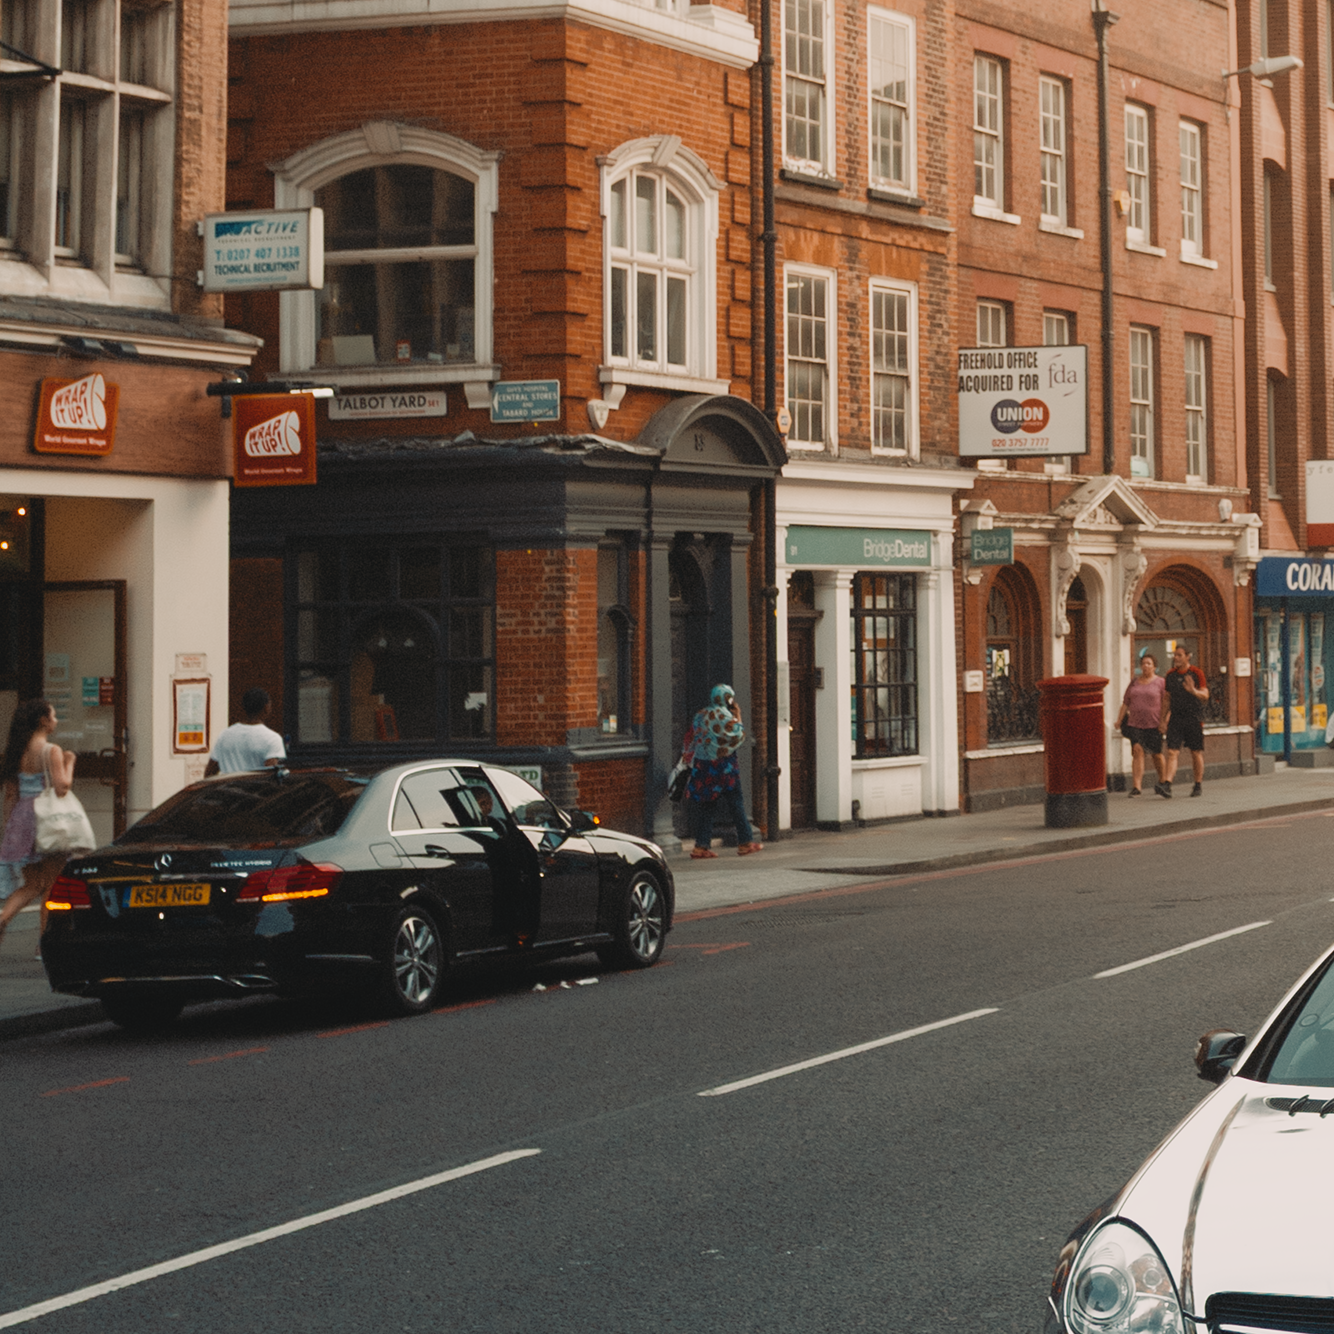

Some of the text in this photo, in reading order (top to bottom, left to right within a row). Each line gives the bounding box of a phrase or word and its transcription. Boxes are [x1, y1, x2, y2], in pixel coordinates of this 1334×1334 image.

[255, 248, 273, 260] 407
[214, 261, 300, 276] TECHNICAL RECRUITMENT
[958, 352, 1039, 371] FREEHOLD OFFICE
[1047, 363, 1078, 388] fda
[958, 374, 1040, 394] ACQUIRED FOR
[55, 381, 88, 407] WRAP
[499, 391, 558, 402] CENTRAL STORES
[55, 396, 91, 425] IT UP!
[336, 396, 386, 411] TALBOT
[389, 395, 426, 409] YARD
[502, 408, 528, 417] TABARD
[996, 407, 1044, 421] UNION
[249, 419, 282, 440] WRAP
[249, 430, 286, 453] IT UP!
[992, 438, 1006, 447] 020
[1030, 437, 1050, 446] 7777
[973, 534, 1009, 548] Bridge
[973, 548, 1010, 560] Dental
[171, 885, 203, 903] NGG
